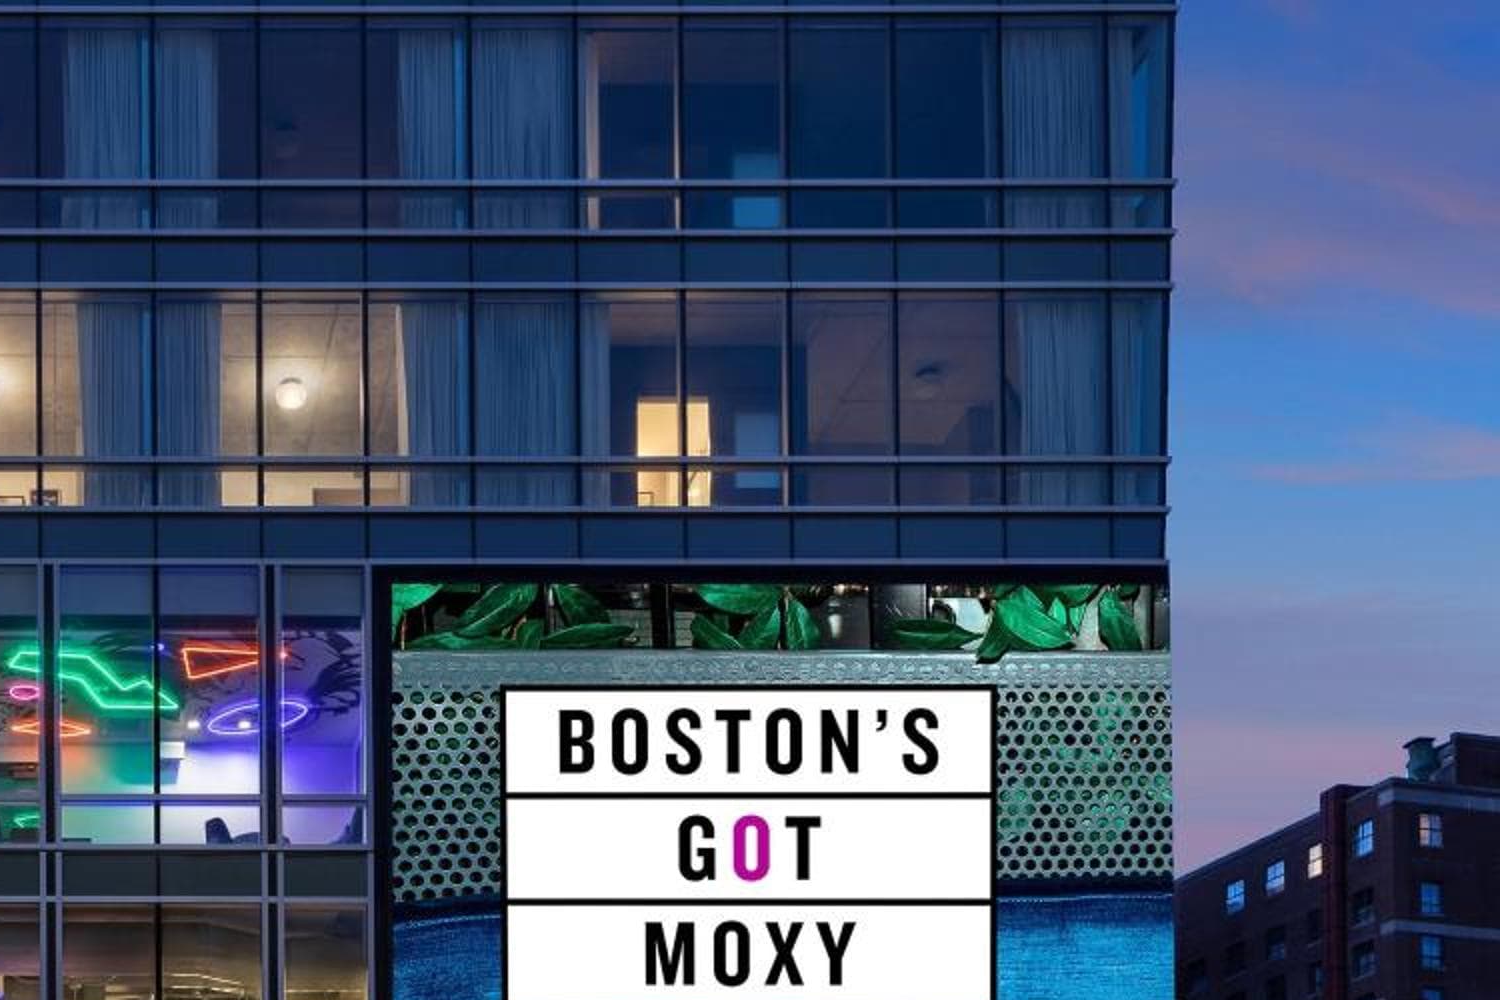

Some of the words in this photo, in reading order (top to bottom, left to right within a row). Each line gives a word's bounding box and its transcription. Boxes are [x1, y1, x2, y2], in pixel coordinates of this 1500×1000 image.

[558, 707, 940, 775] BOSTON'S
[678, 814, 822, 882] GOT
[645, 920, 857, 987] MOXY
